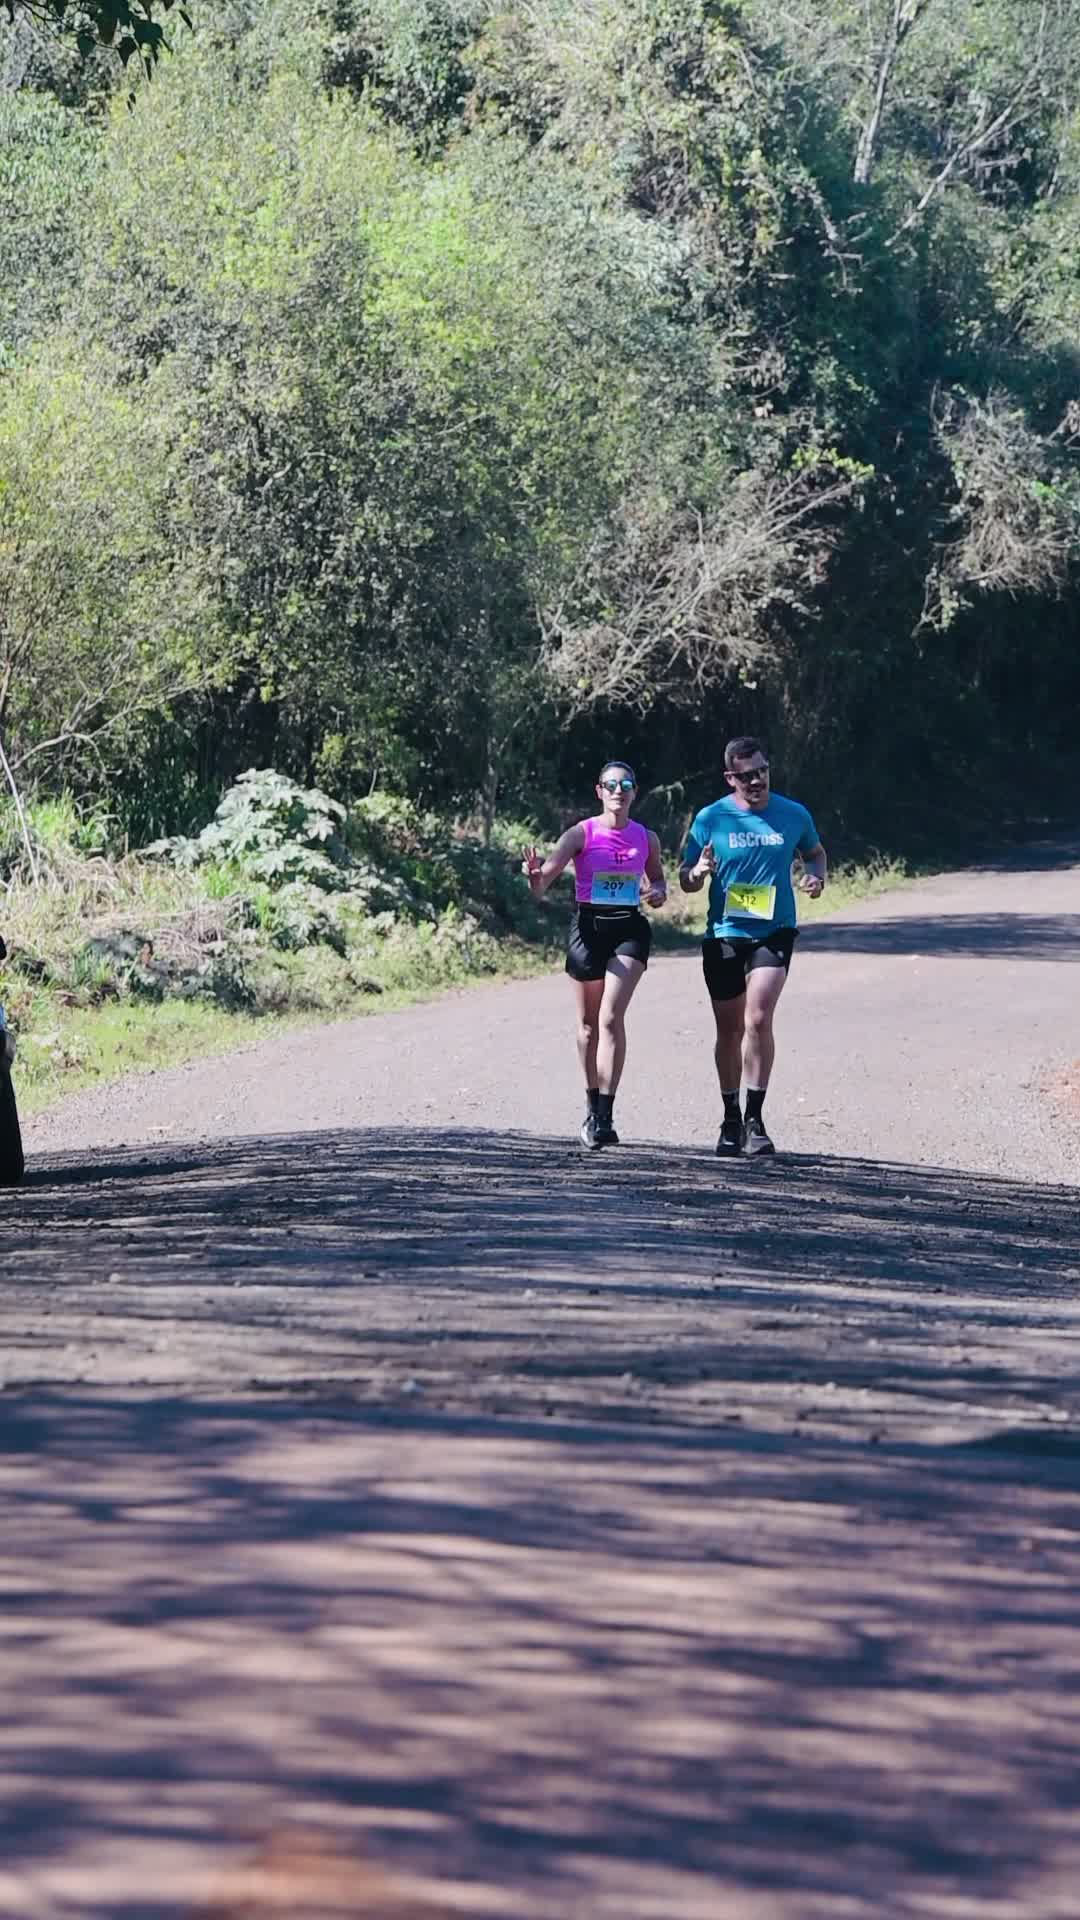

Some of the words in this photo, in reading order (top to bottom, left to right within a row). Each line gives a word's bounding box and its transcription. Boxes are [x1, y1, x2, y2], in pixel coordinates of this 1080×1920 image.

[728, 832, 784, 849] BSCross
[602, 881, 625, 891] 207
[738, 894, 757, 905] 312
